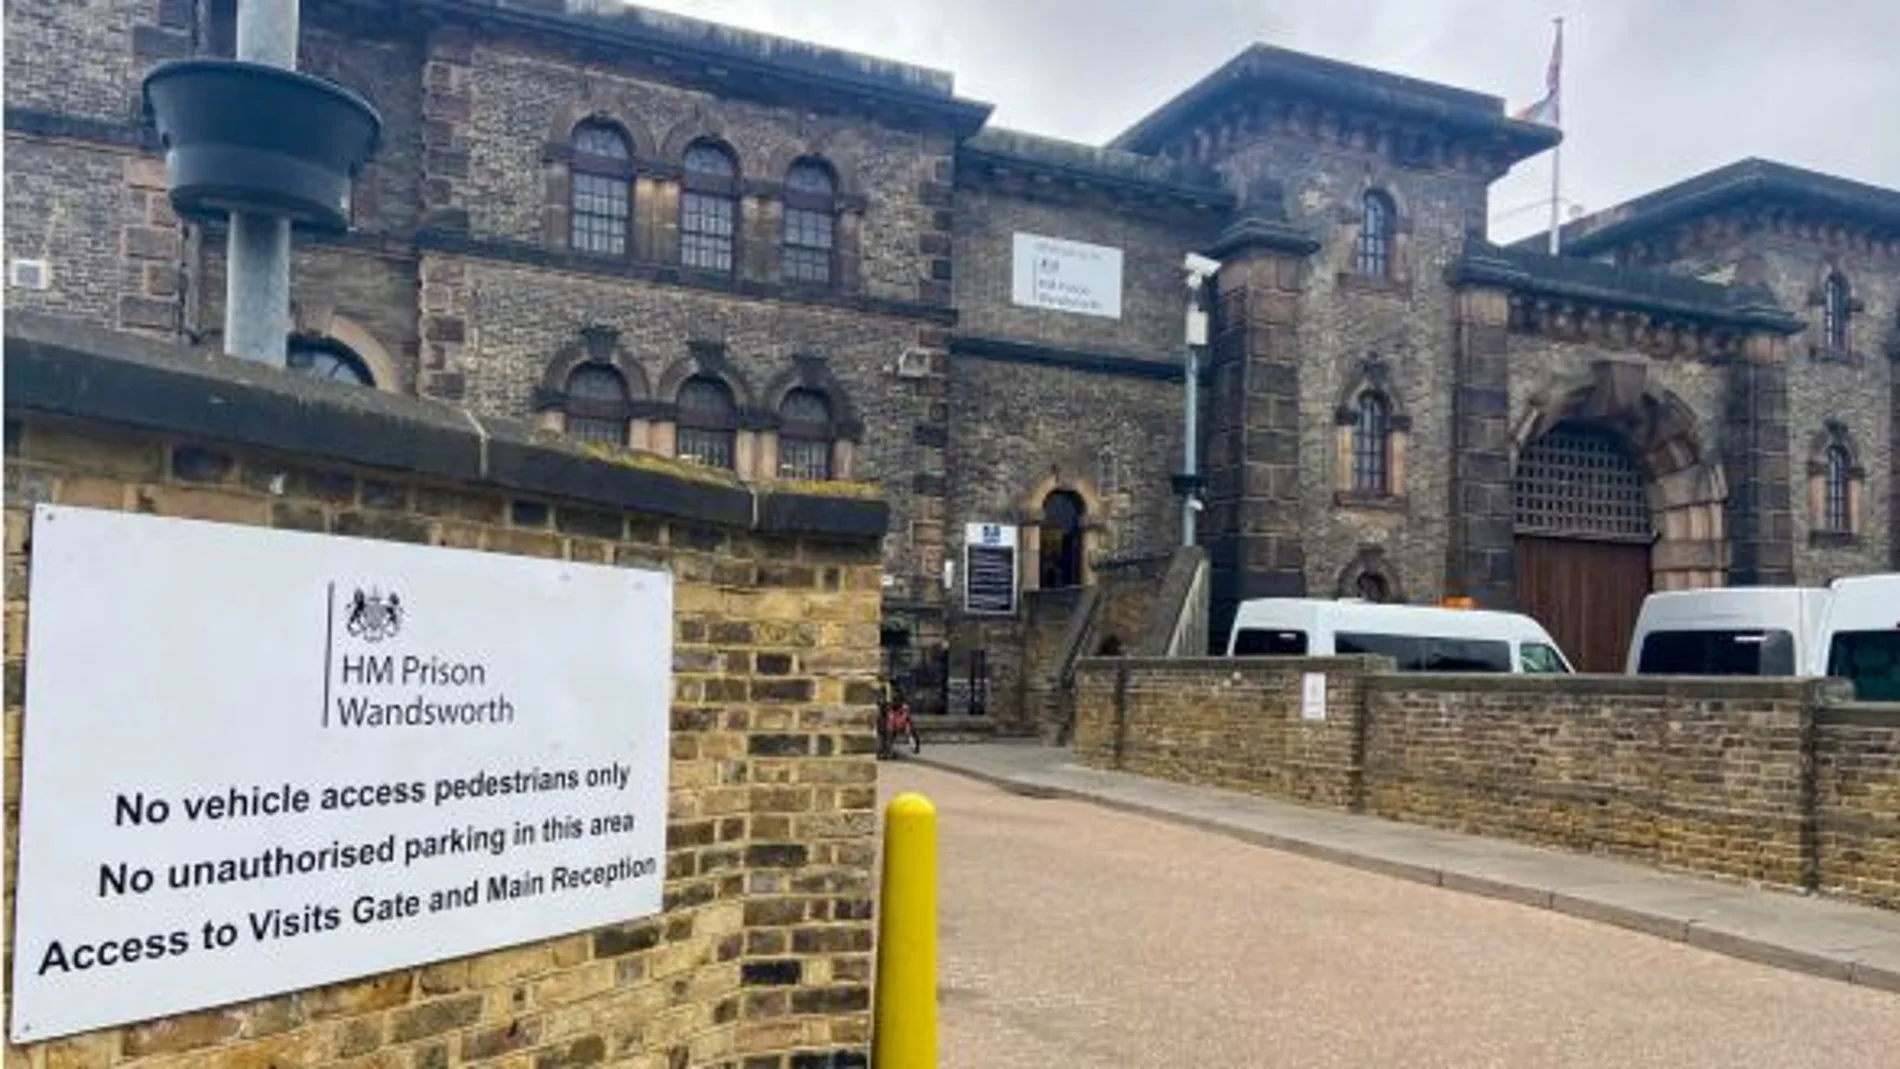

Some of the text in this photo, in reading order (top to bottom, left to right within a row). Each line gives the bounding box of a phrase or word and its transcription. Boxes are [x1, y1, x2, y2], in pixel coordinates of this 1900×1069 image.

[342, 655, 485, 686] HM Prison
[337, 694, 514, 727] Wandsworth
[115, 761, 631, 827] No vehicle access pedestrians only
[98, 813, 634, 898] No unauthorised parking in this area
[37, 855, 656, 977] Access to Visits Gate and Main Reception
